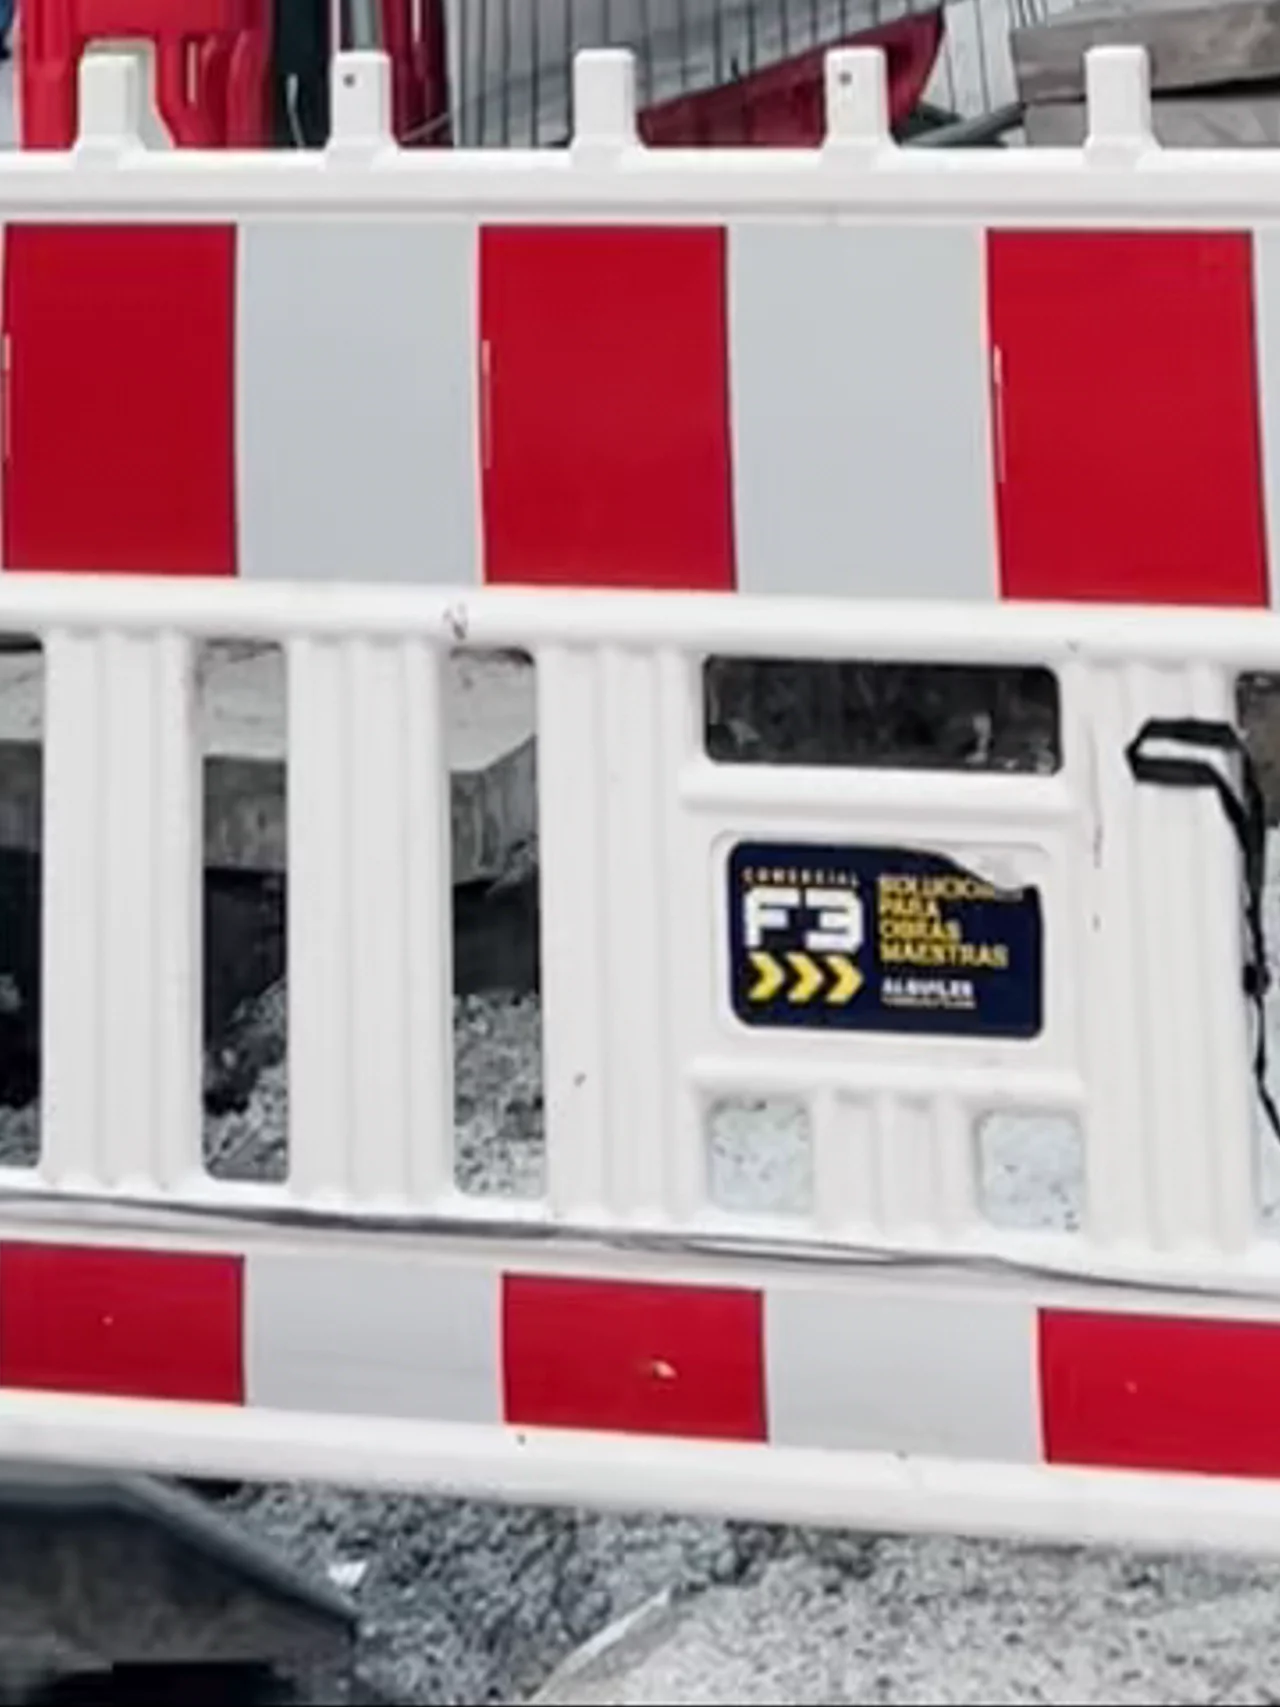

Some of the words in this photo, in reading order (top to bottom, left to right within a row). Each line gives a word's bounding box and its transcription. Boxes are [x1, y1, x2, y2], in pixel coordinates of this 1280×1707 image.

[878, 875, 1022, 900] SOLUCION
[743, 886, 863, 954] F3
[879, 940, 1009, 969] MAESTRAS
